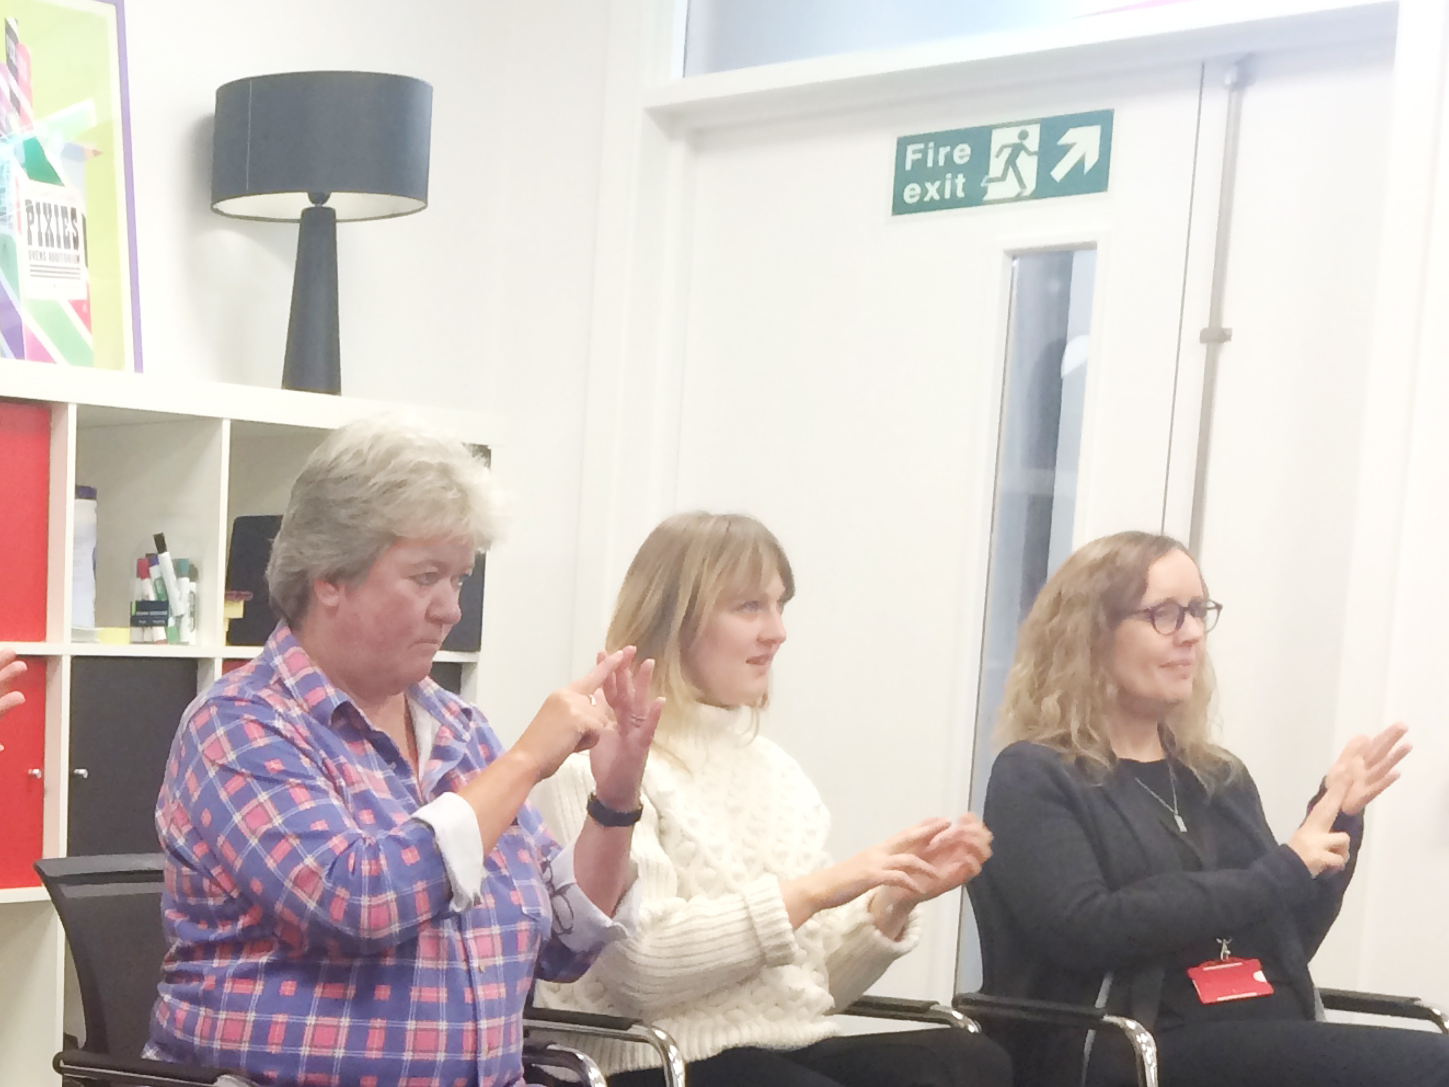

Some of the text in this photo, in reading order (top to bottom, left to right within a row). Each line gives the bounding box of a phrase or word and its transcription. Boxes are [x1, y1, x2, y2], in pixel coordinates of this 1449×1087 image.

[904, 141, 972, 172] Fire
[903, 173, 967, 205] exit
[25, 199, 79, 251] PIXIES
